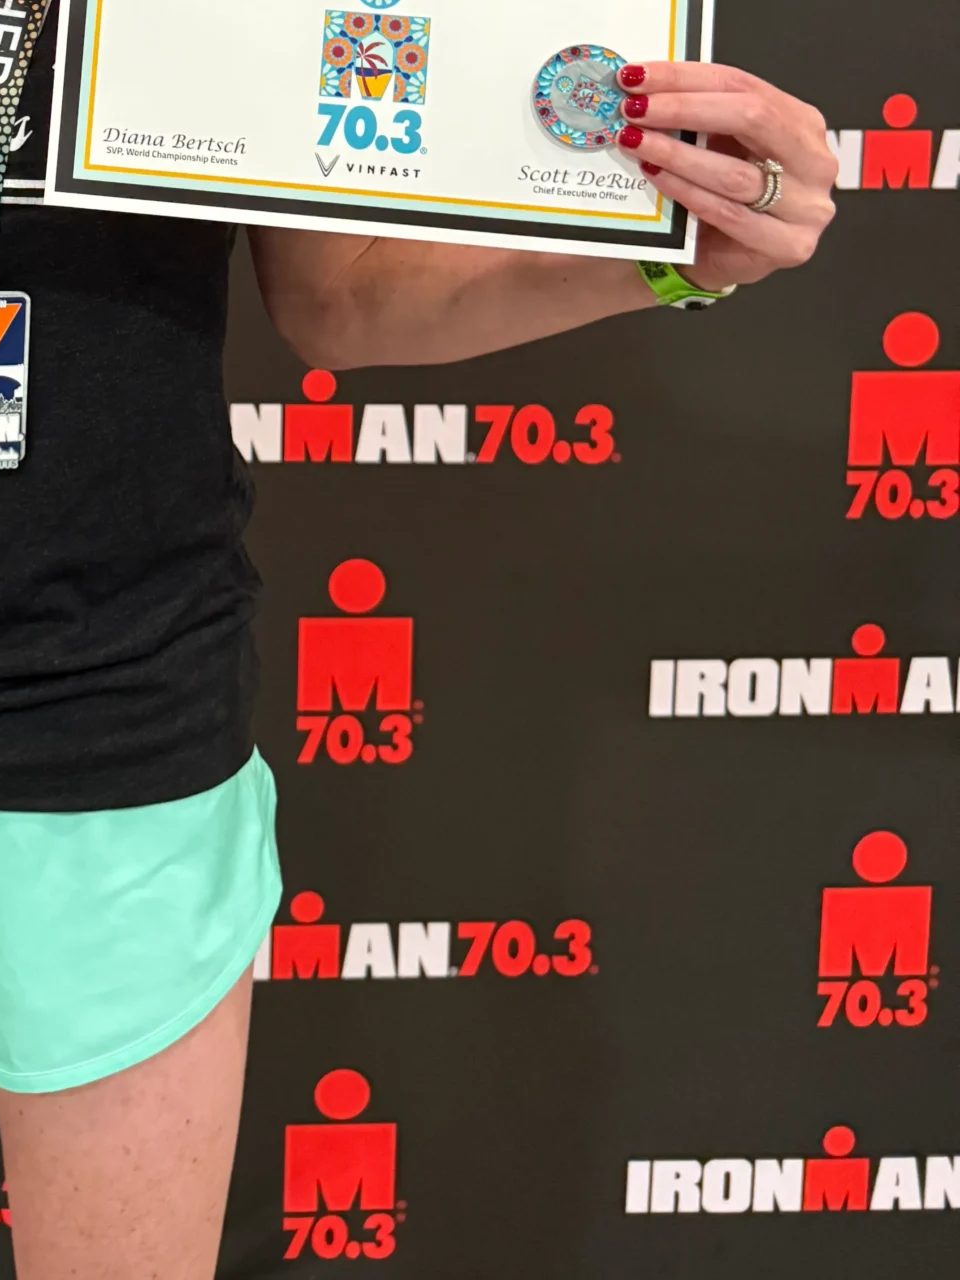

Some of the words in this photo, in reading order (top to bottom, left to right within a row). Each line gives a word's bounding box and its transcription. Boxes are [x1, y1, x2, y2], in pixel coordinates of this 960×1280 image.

[102, 127, 165, 148] Diana
[171, 133, 247, 155] Bertsch
[317, 103, 423, 155] 70.3
[106, 146, 124, 157] SVP,
[126, 148, 150, 158] World
[151, 150, 209, 164] Championship
[210, 155, 238, 166] Events
[346, 163, 421, 179] VINFAST
[518, 164, 570, 185] Scott
[577, 170, 647, 191] DeRue
[533, 185, 555, 195] Chief
[556, 188, 598, 199] Executive
[598, 191, 629, 202] Officer
[475, 405, 615, 465] 70.3
[846, 469, 960, 520] 70.3
[650, 658, 960, 717] IRONMA
[297, 714, 413, 765] 70.3
[458, 921, 592, 977] 70.3
[817, 979, 928, 1028] 70.3
[283, 1214, 396, 1260] 70.3
